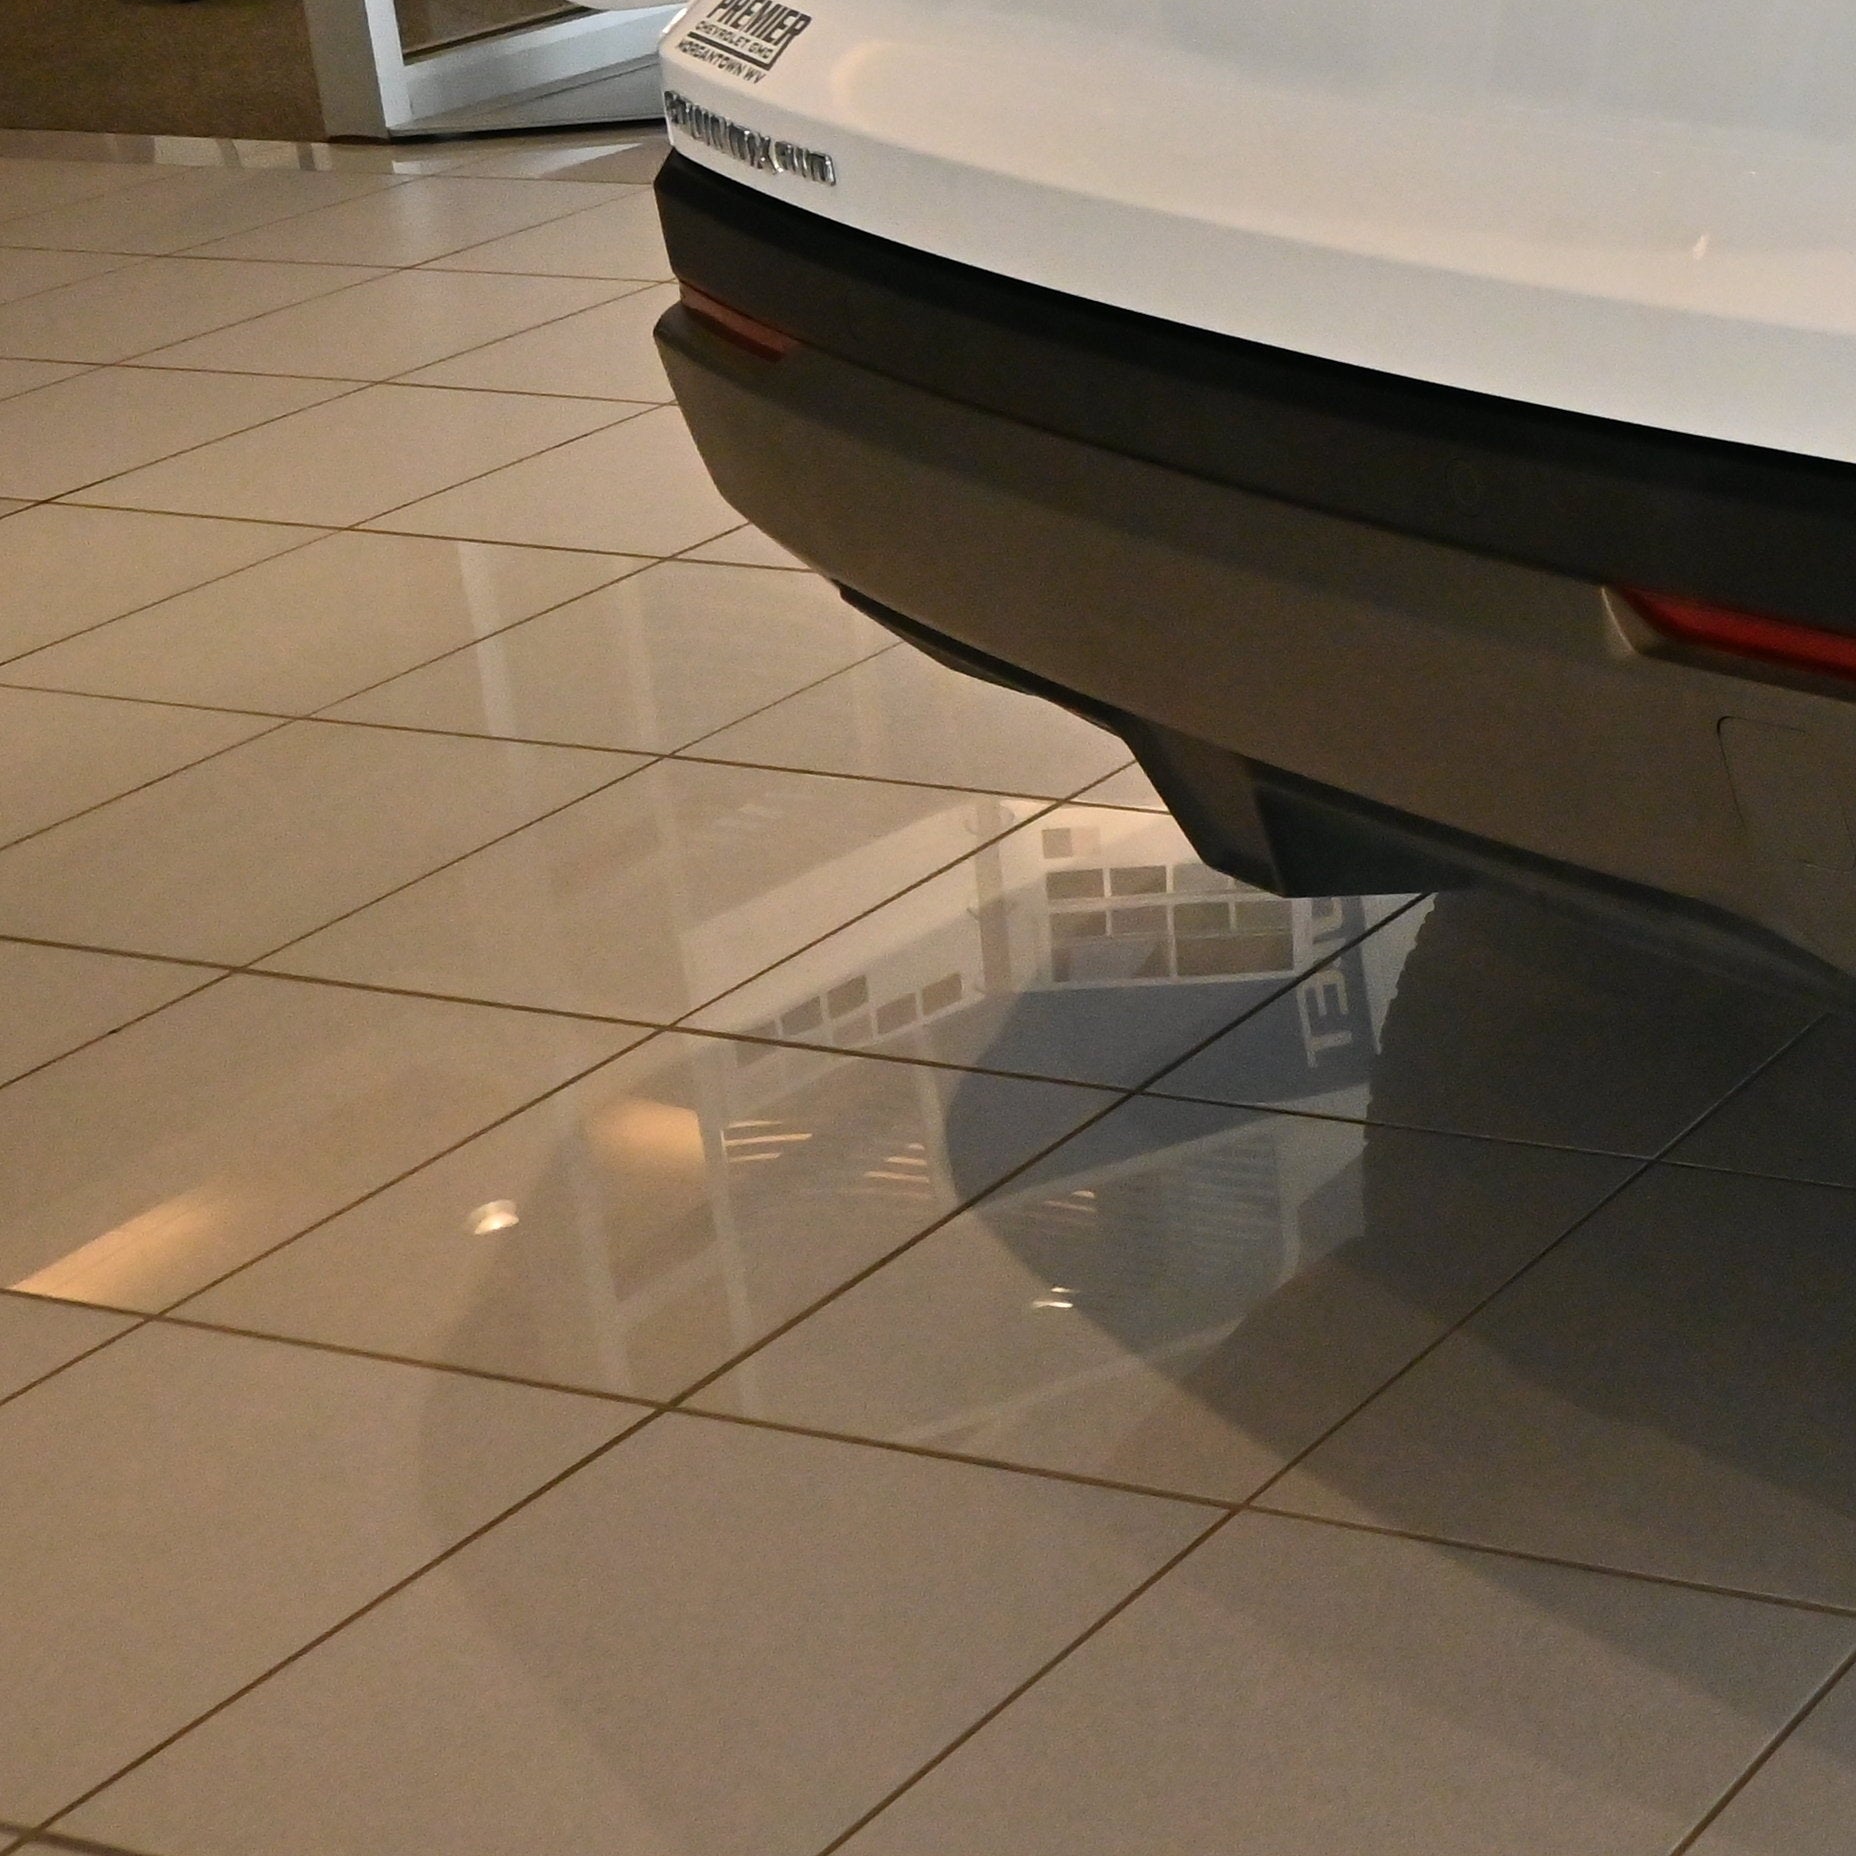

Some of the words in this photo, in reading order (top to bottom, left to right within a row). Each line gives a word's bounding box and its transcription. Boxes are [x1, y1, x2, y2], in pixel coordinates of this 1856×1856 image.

[695, 20, 752, 48] CHEVROLET
[749, 42, 774, 59] GMC
[743, 66, 766, 84] WV
